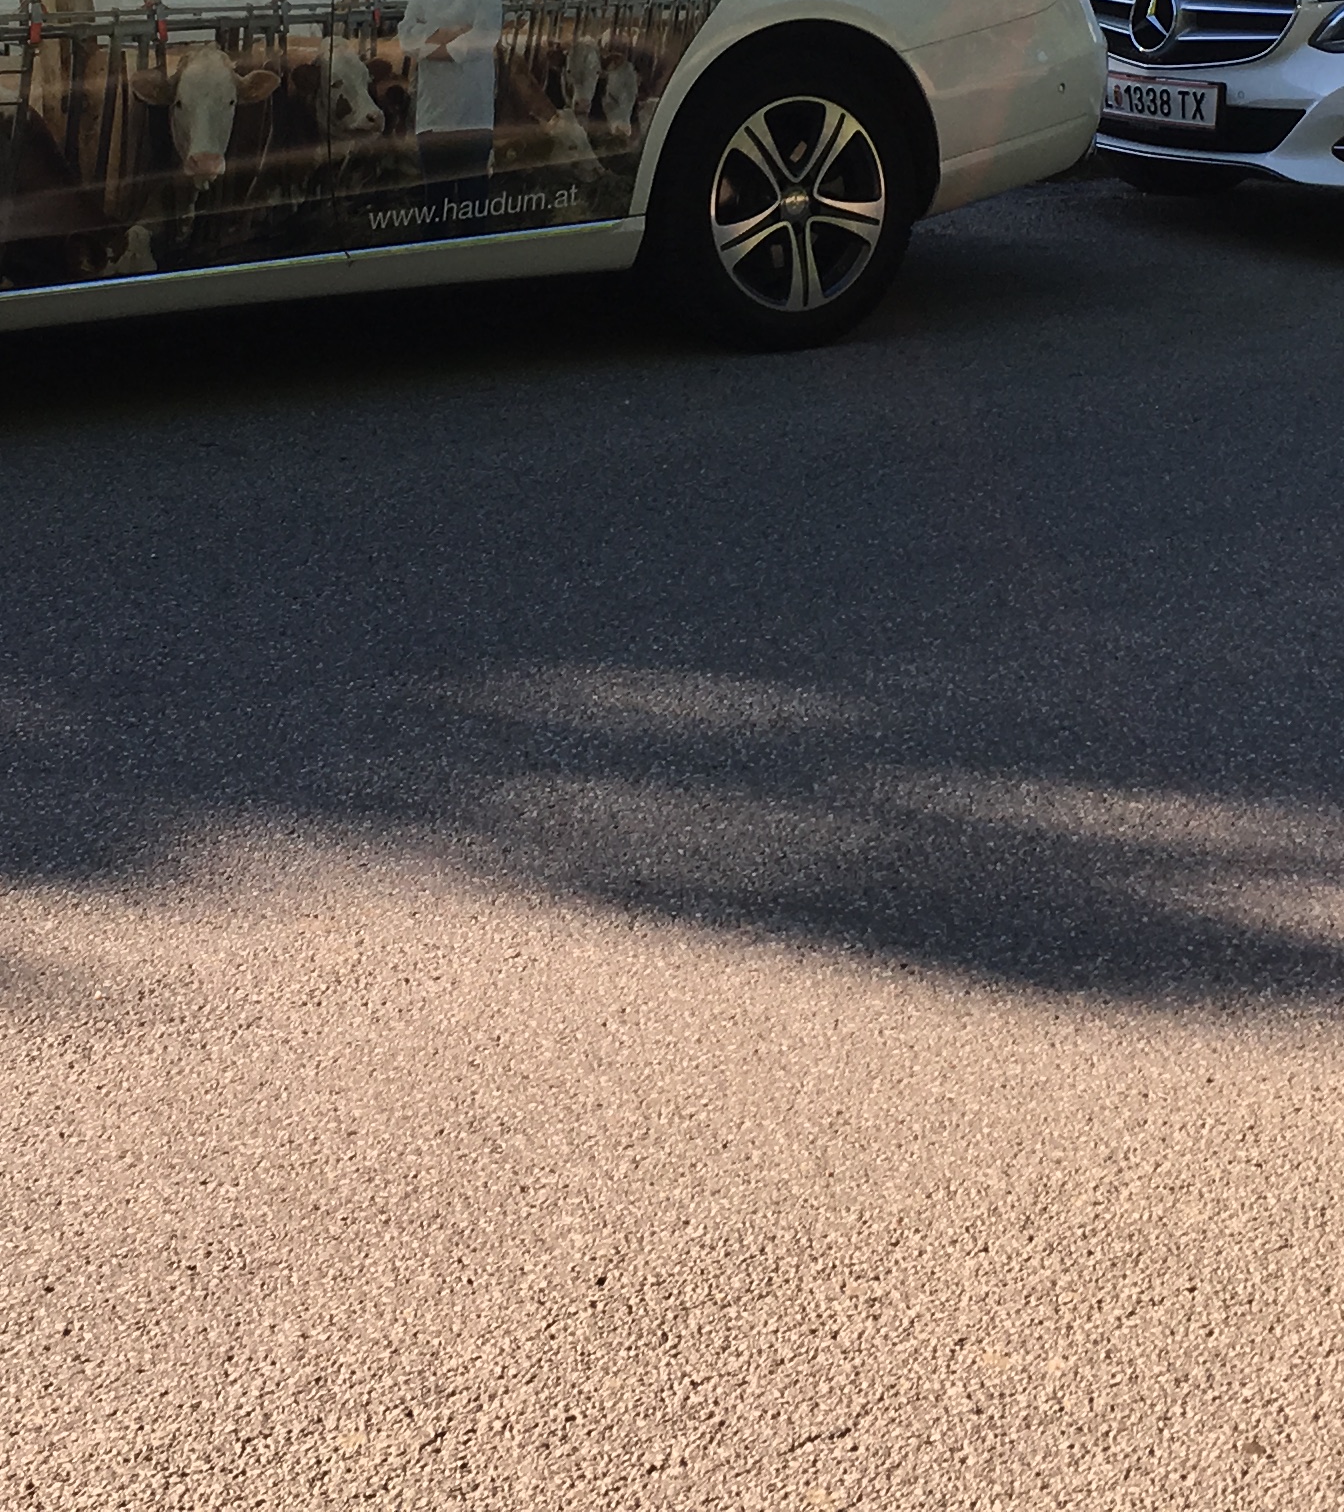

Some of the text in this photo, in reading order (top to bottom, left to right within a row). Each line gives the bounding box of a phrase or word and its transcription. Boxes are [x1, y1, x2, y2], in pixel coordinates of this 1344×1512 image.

[1123, 84, 1172, 117] 1338
[1177, 90, 1206, 122] TX
[368, 185, 579, 230] www.haudum.at
